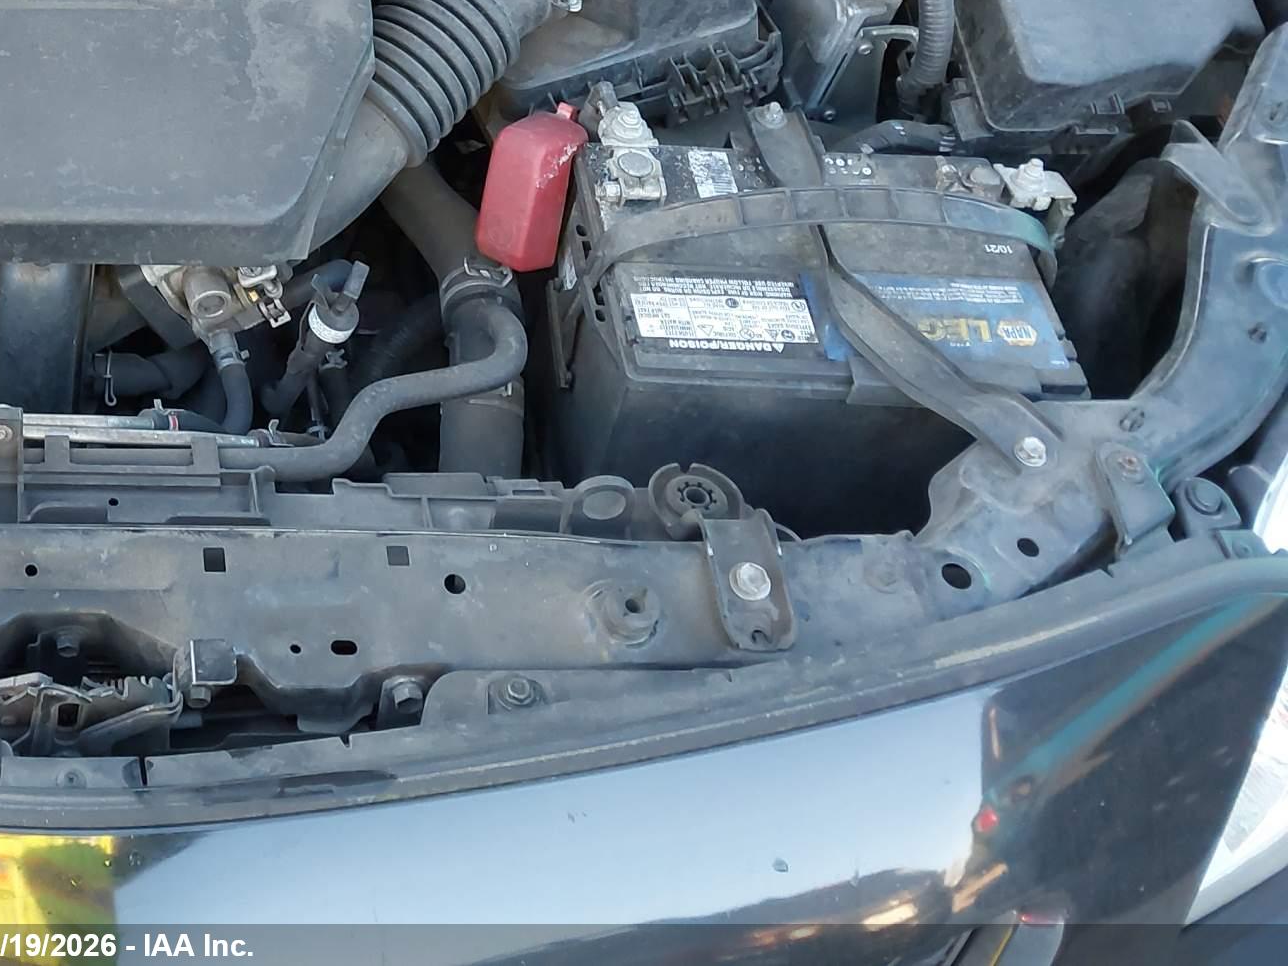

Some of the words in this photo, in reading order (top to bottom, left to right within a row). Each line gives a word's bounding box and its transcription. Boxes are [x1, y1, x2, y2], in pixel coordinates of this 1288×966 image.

[983, 243, 1013, 255] 10/21
[1003, 327, 1032, 340] NAPA
[669, 339, 772, 352] DANGER/POISON
